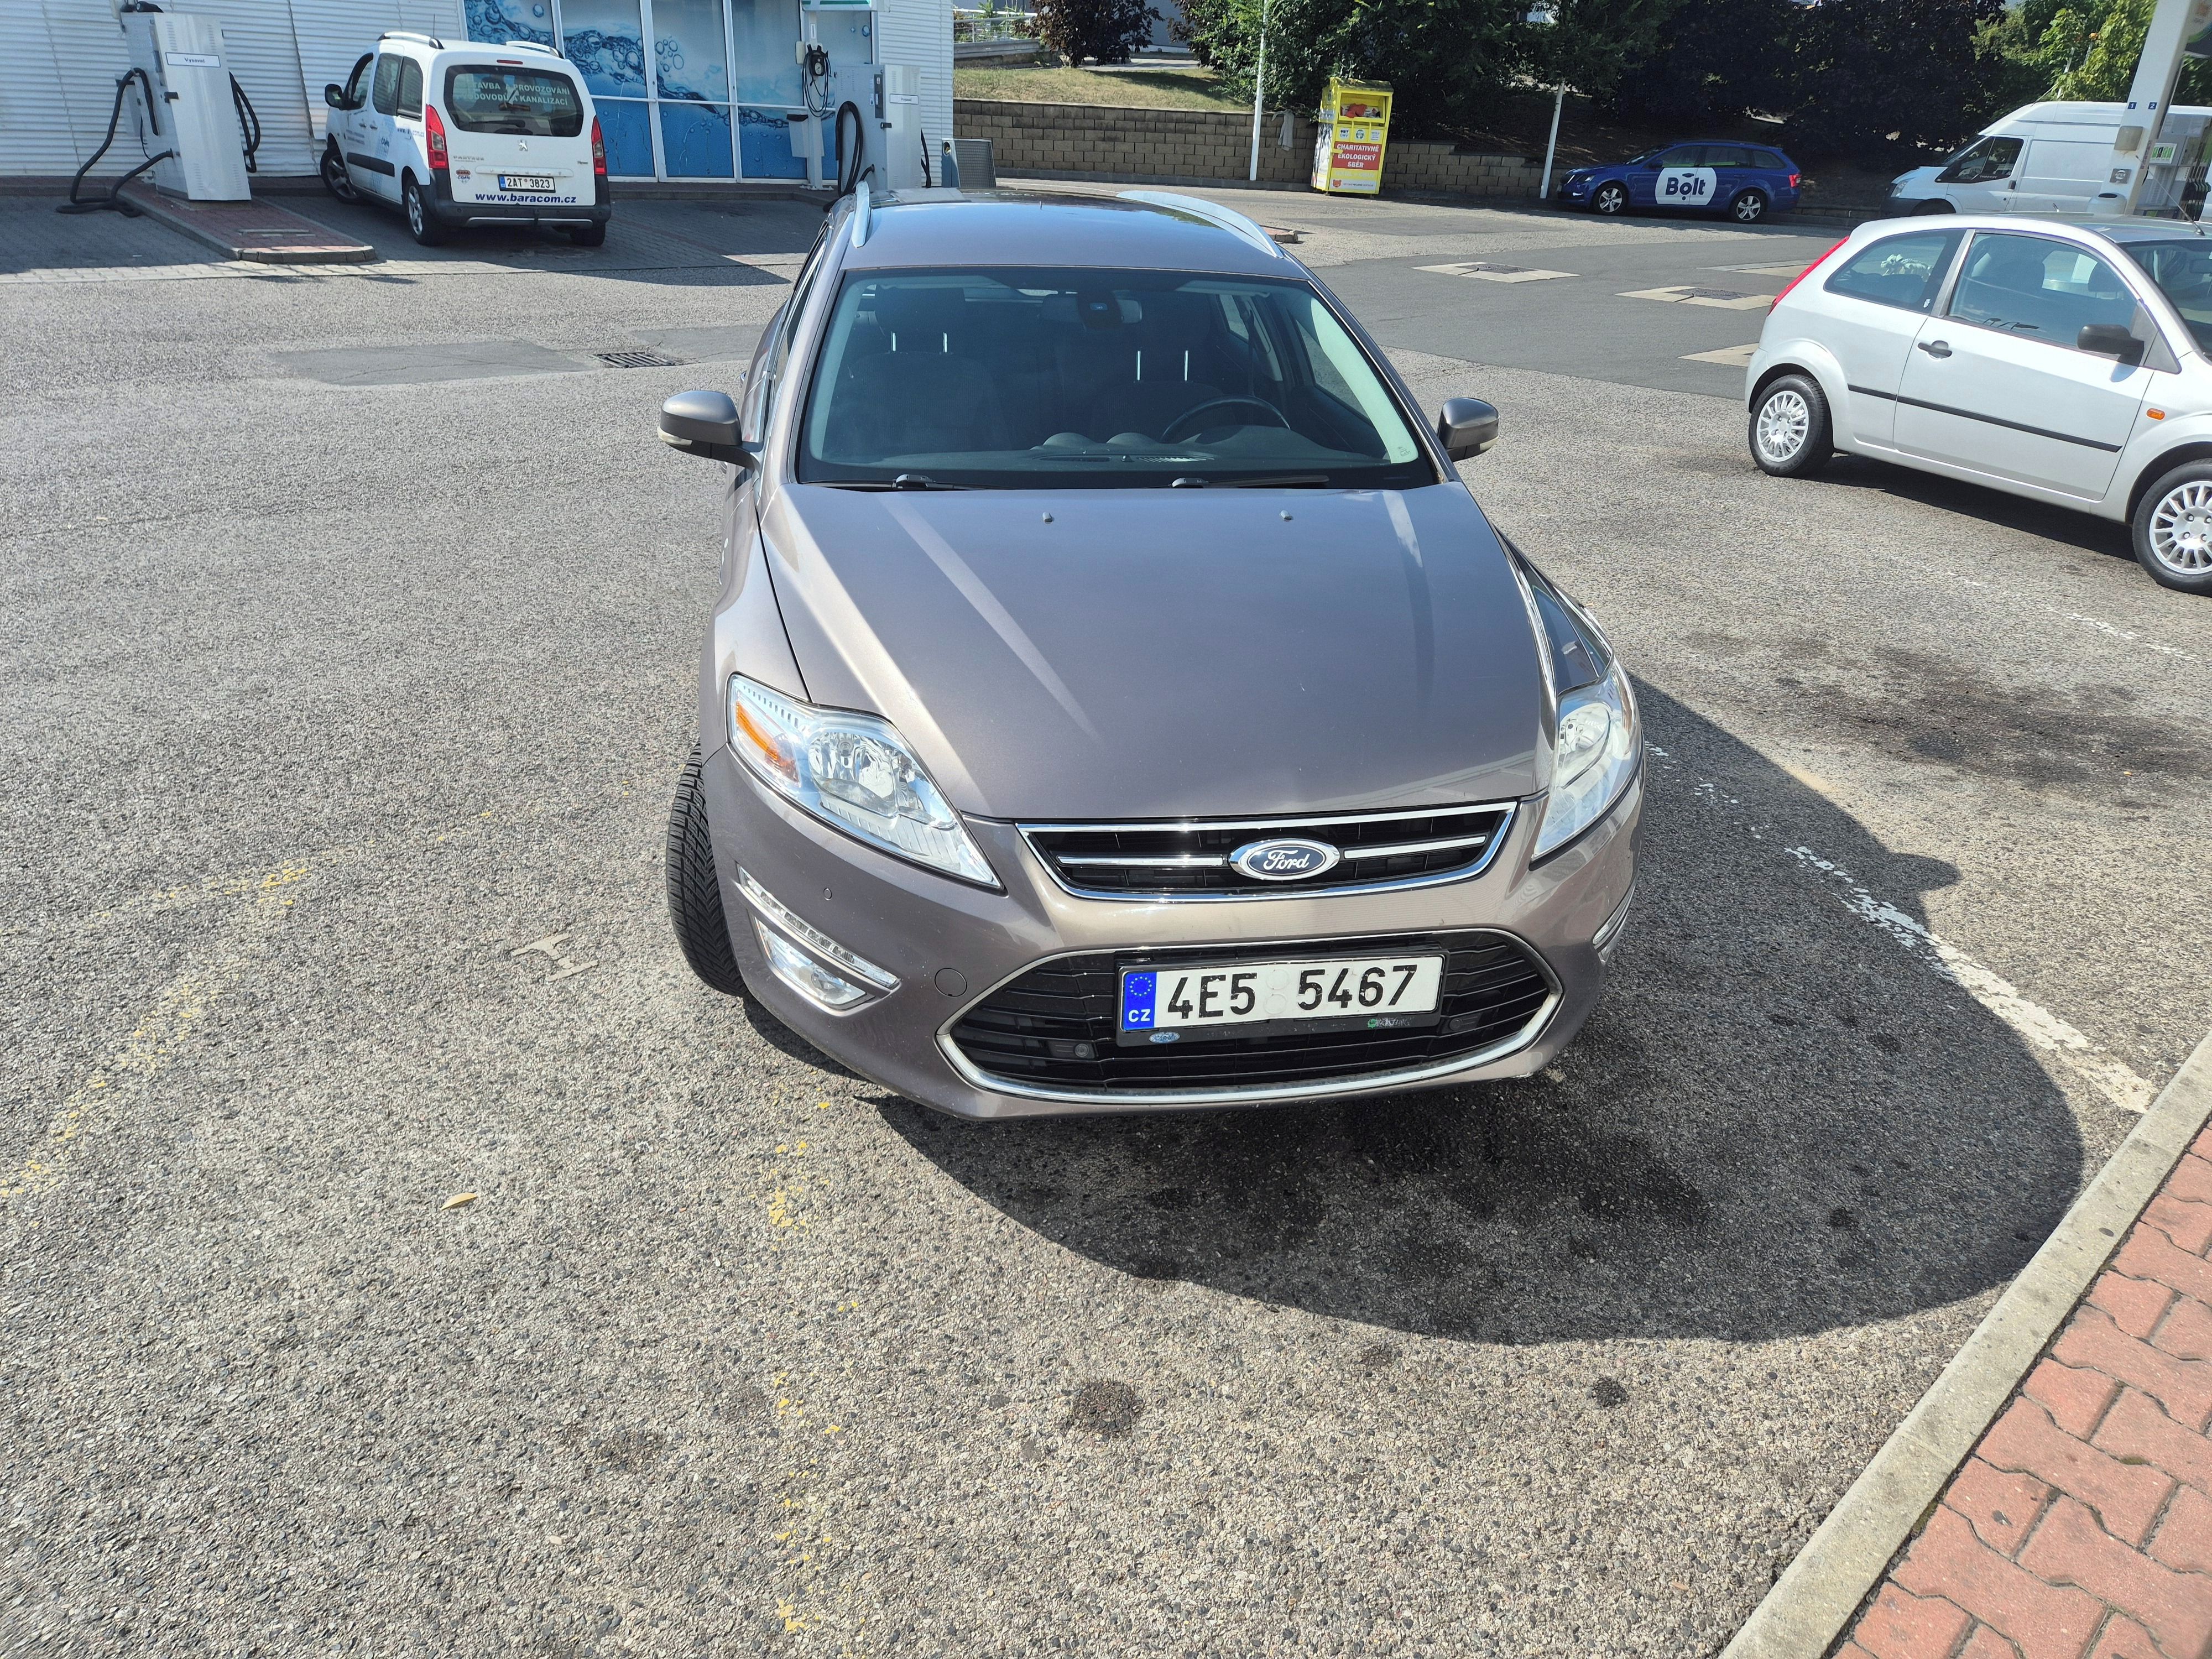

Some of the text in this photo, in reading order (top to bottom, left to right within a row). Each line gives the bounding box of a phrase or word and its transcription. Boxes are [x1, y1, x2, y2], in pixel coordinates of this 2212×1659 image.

[514, 84, 570, 95] PROVOZOVÁNÍ
[520, 95, 567, 106] KANALIZACÍ
[1337, 143, 1379, 152] CHARITATIVNÉ
[507, 178, 522, 187] 2AT
[529, 179, 550, 189] 3823
[1665, 177, 1706, 195] Bolt
[475, 193, 576, 204] www.baracom.cz
[1263, 849, 1311, 870] Ford
[1167, 964, 1418, 1019] 4E5 5467
[1128, 1009, 1151, 1022] CZ
